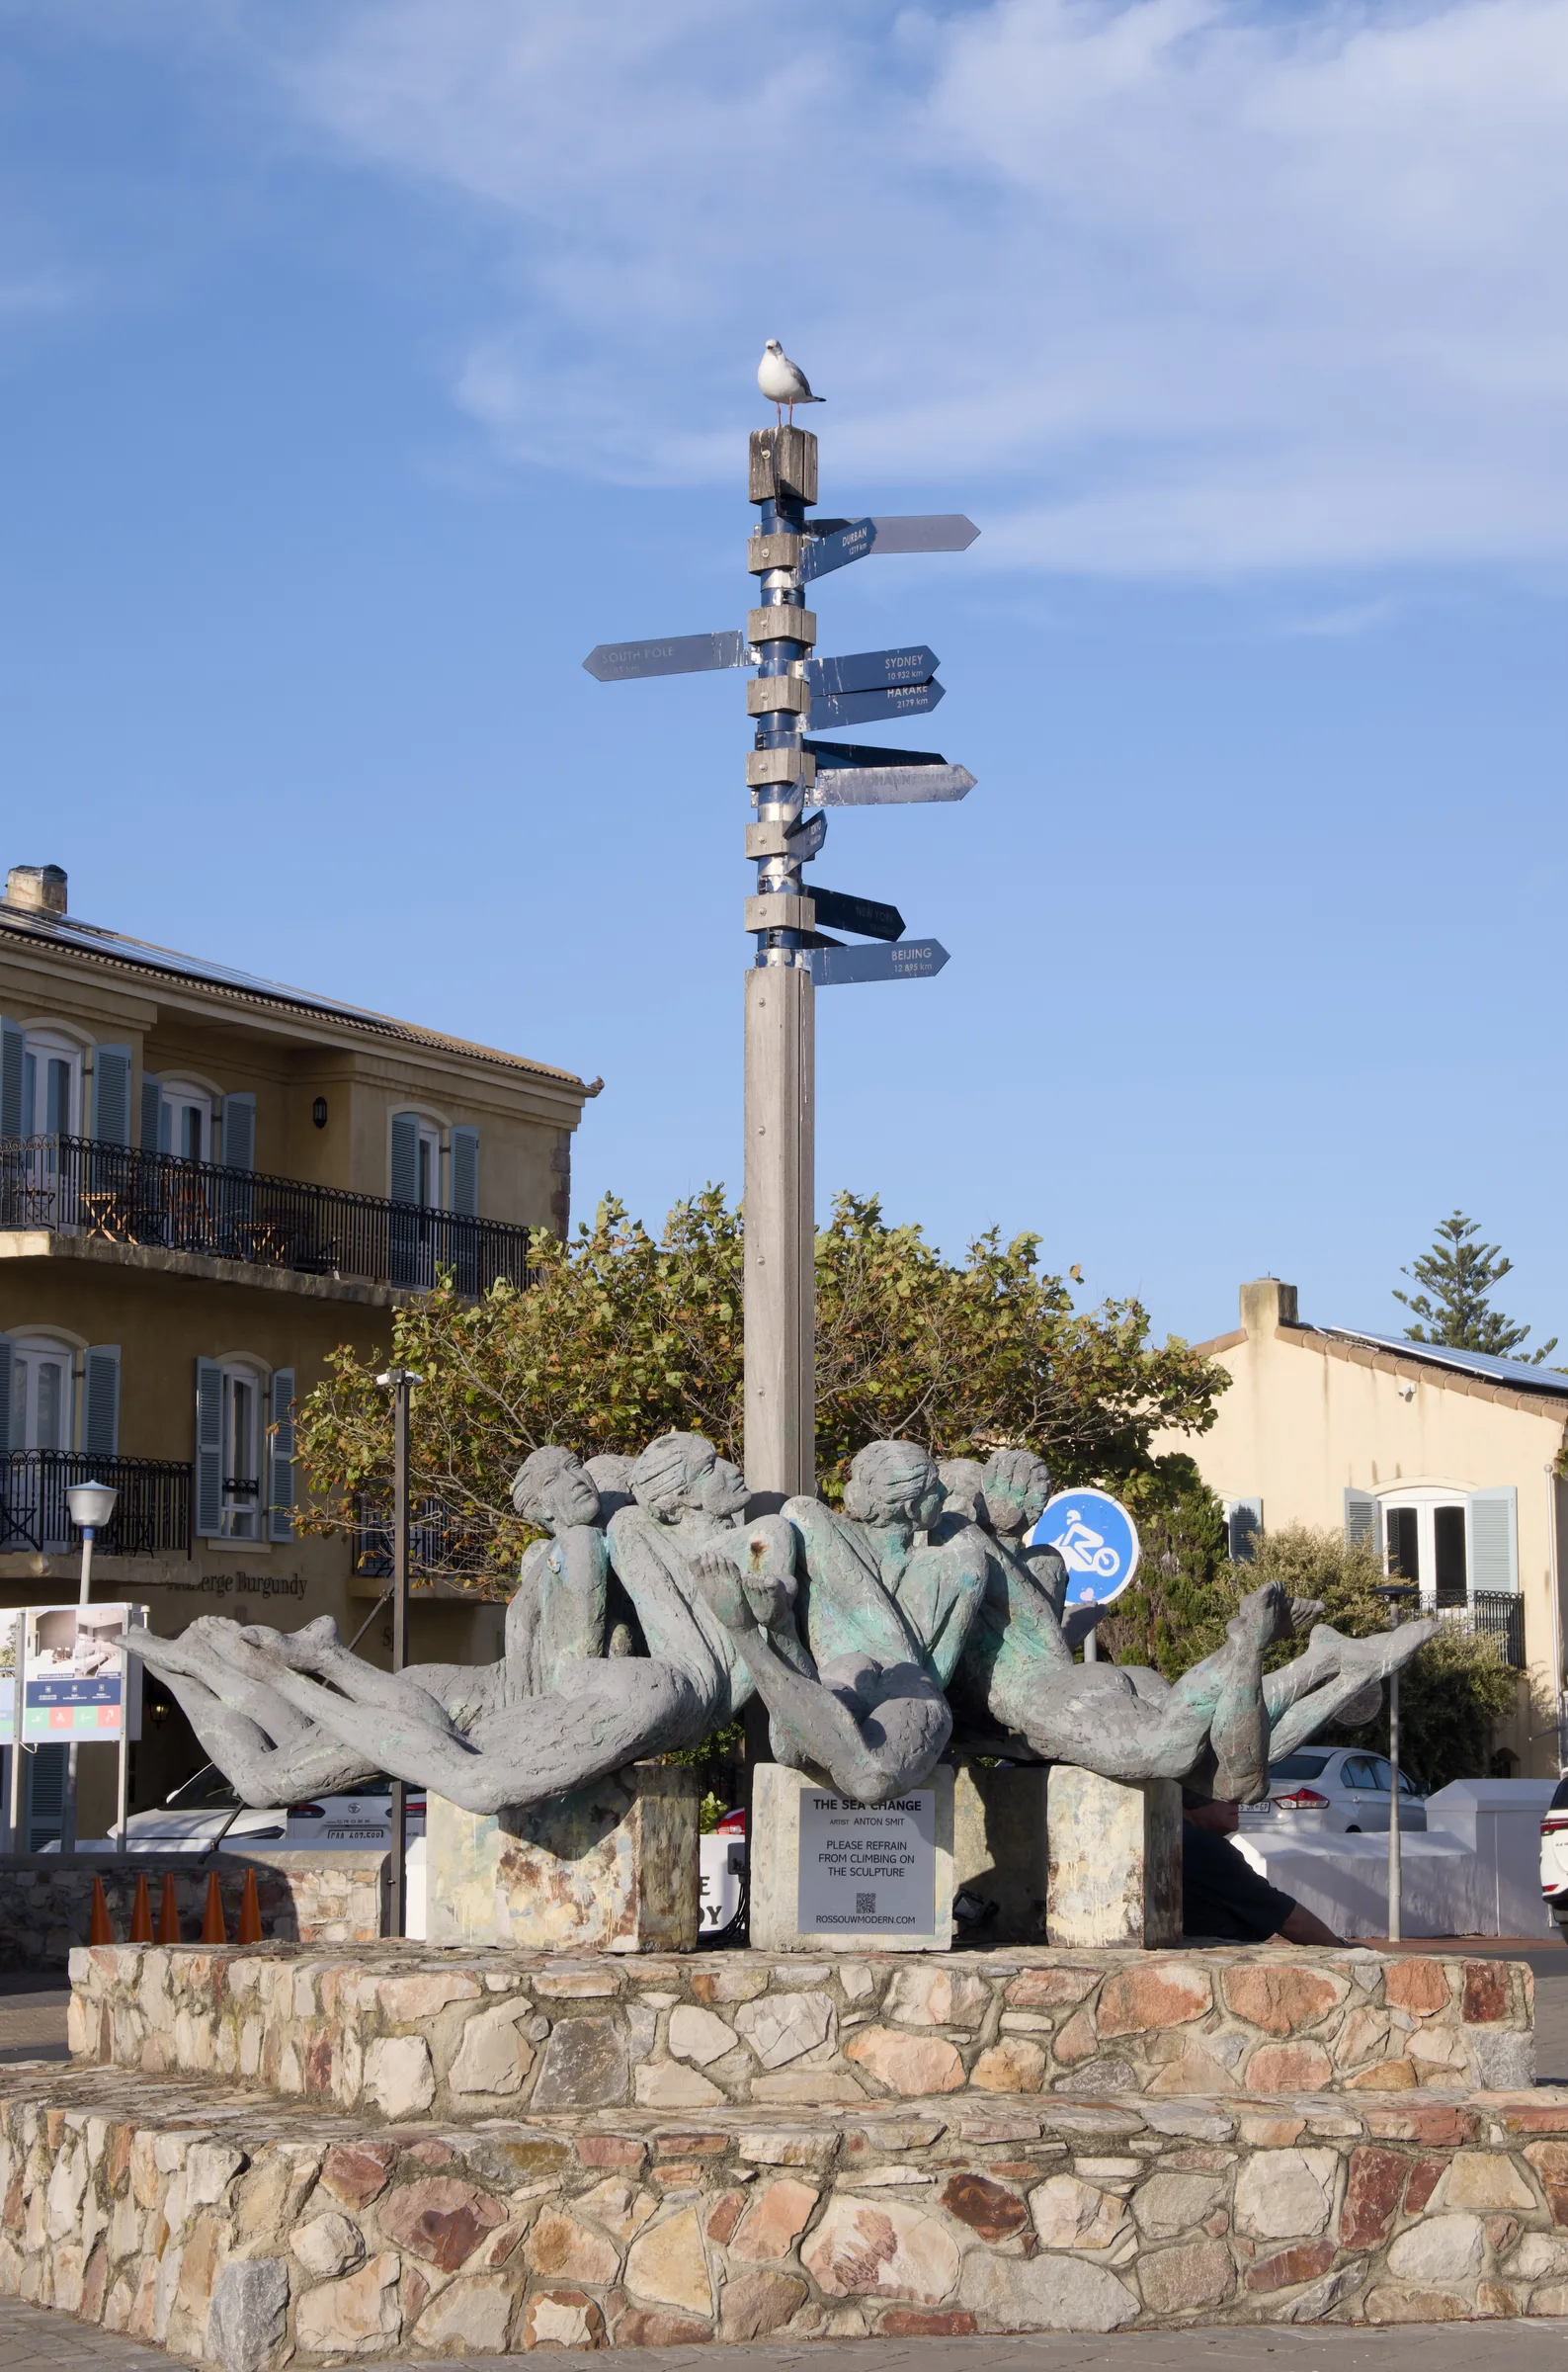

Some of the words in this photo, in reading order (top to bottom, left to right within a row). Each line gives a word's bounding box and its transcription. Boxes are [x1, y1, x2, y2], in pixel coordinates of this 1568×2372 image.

[842, 527, 867, 547] DURBAN
[602, 650, 640, 664] SOUTH
[644, 645, 674, 659] POLE
[884, 654, 924, 669] SYDNEY
[625, 664, 639, 673] km
[887, 685, 929, 699] HARARE
[897, 699, 915, 709] 2179
[891, 948, 932, 961] BEIJING
[236, 1571, 308, 1600] Burgundy
[813, 1799, 838, 1810] THE
[842, 1799, 867, 1811] SEA
[870, 1800, 922, 1812] CHANGE
[853, 1818, 883, 1826] ANTON
[826, 1840, 864, 1850] PLEASE
[866, 1840, 907, 1851] REFRAIN
[818, 1853, 847, 1863] FROM
[850, 1854, 897, 1864] CLIMBING
[899, 1854, 915, 1864] ON
[828, 1867, 847, 1877] THE
[850, 1867, 905, 1878] SCULPTURE
[815, 1914, 916, 1924] ROSSOUWMODERN.COM
